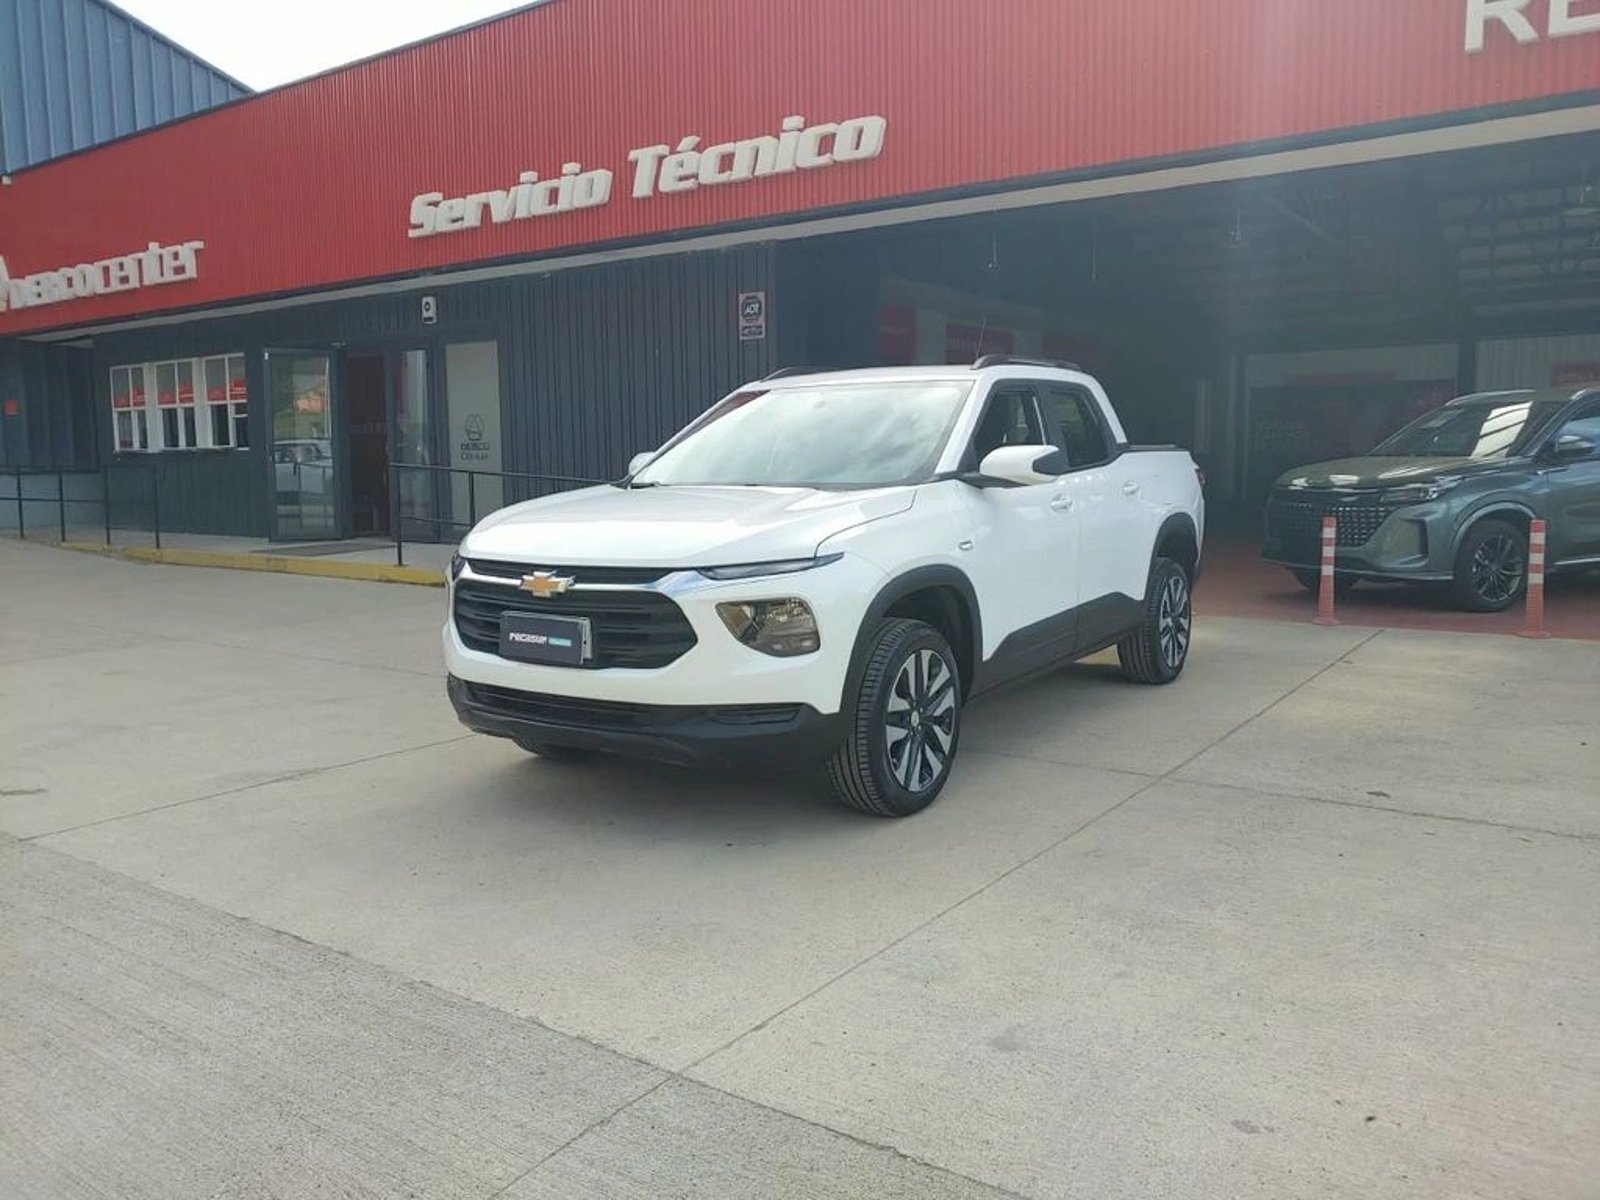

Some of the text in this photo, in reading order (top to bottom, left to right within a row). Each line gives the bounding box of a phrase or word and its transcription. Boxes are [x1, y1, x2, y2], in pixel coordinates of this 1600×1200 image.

[408, 114, 887, 239] Servicio Técnico
[743, 303, 760, 315] ADT
